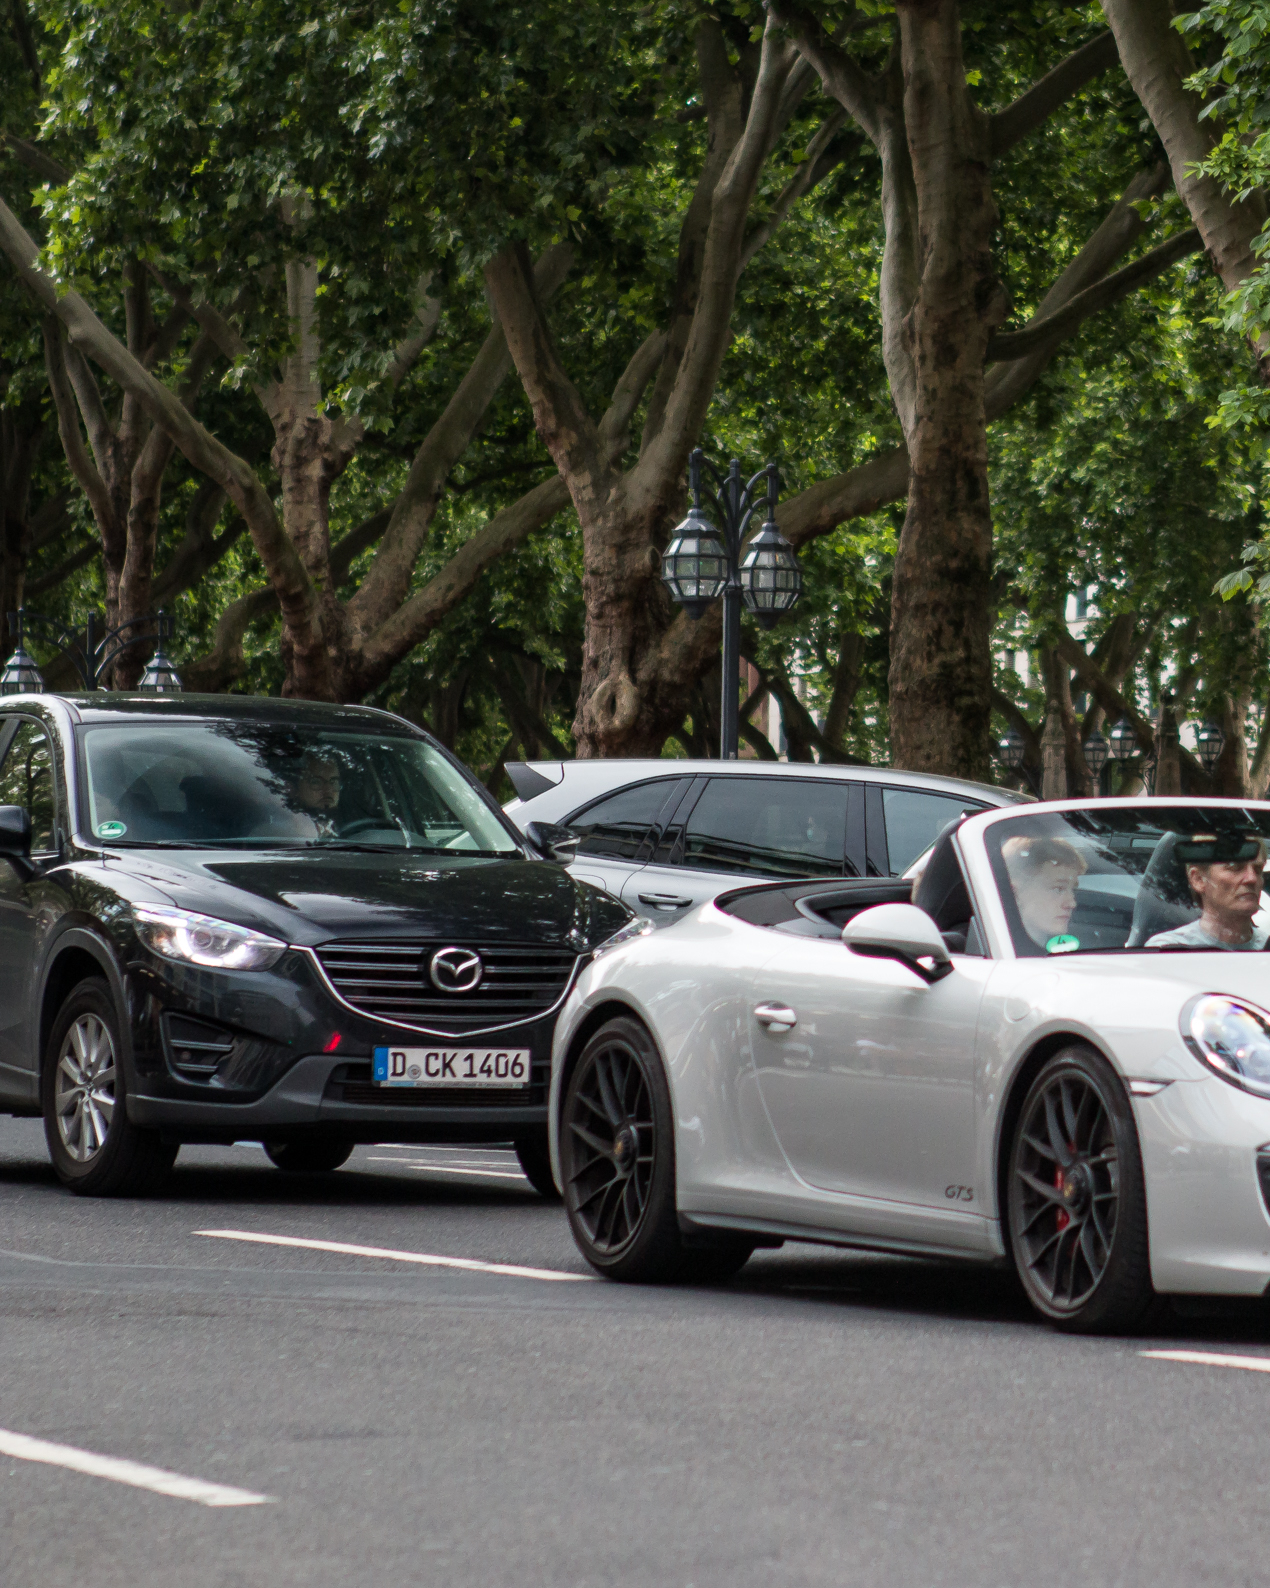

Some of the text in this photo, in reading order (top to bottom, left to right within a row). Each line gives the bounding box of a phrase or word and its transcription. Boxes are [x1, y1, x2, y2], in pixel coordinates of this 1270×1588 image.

[390, 1052, 525, 1079] D CK 1406
[944, 1184, 974, 1202] GTS
